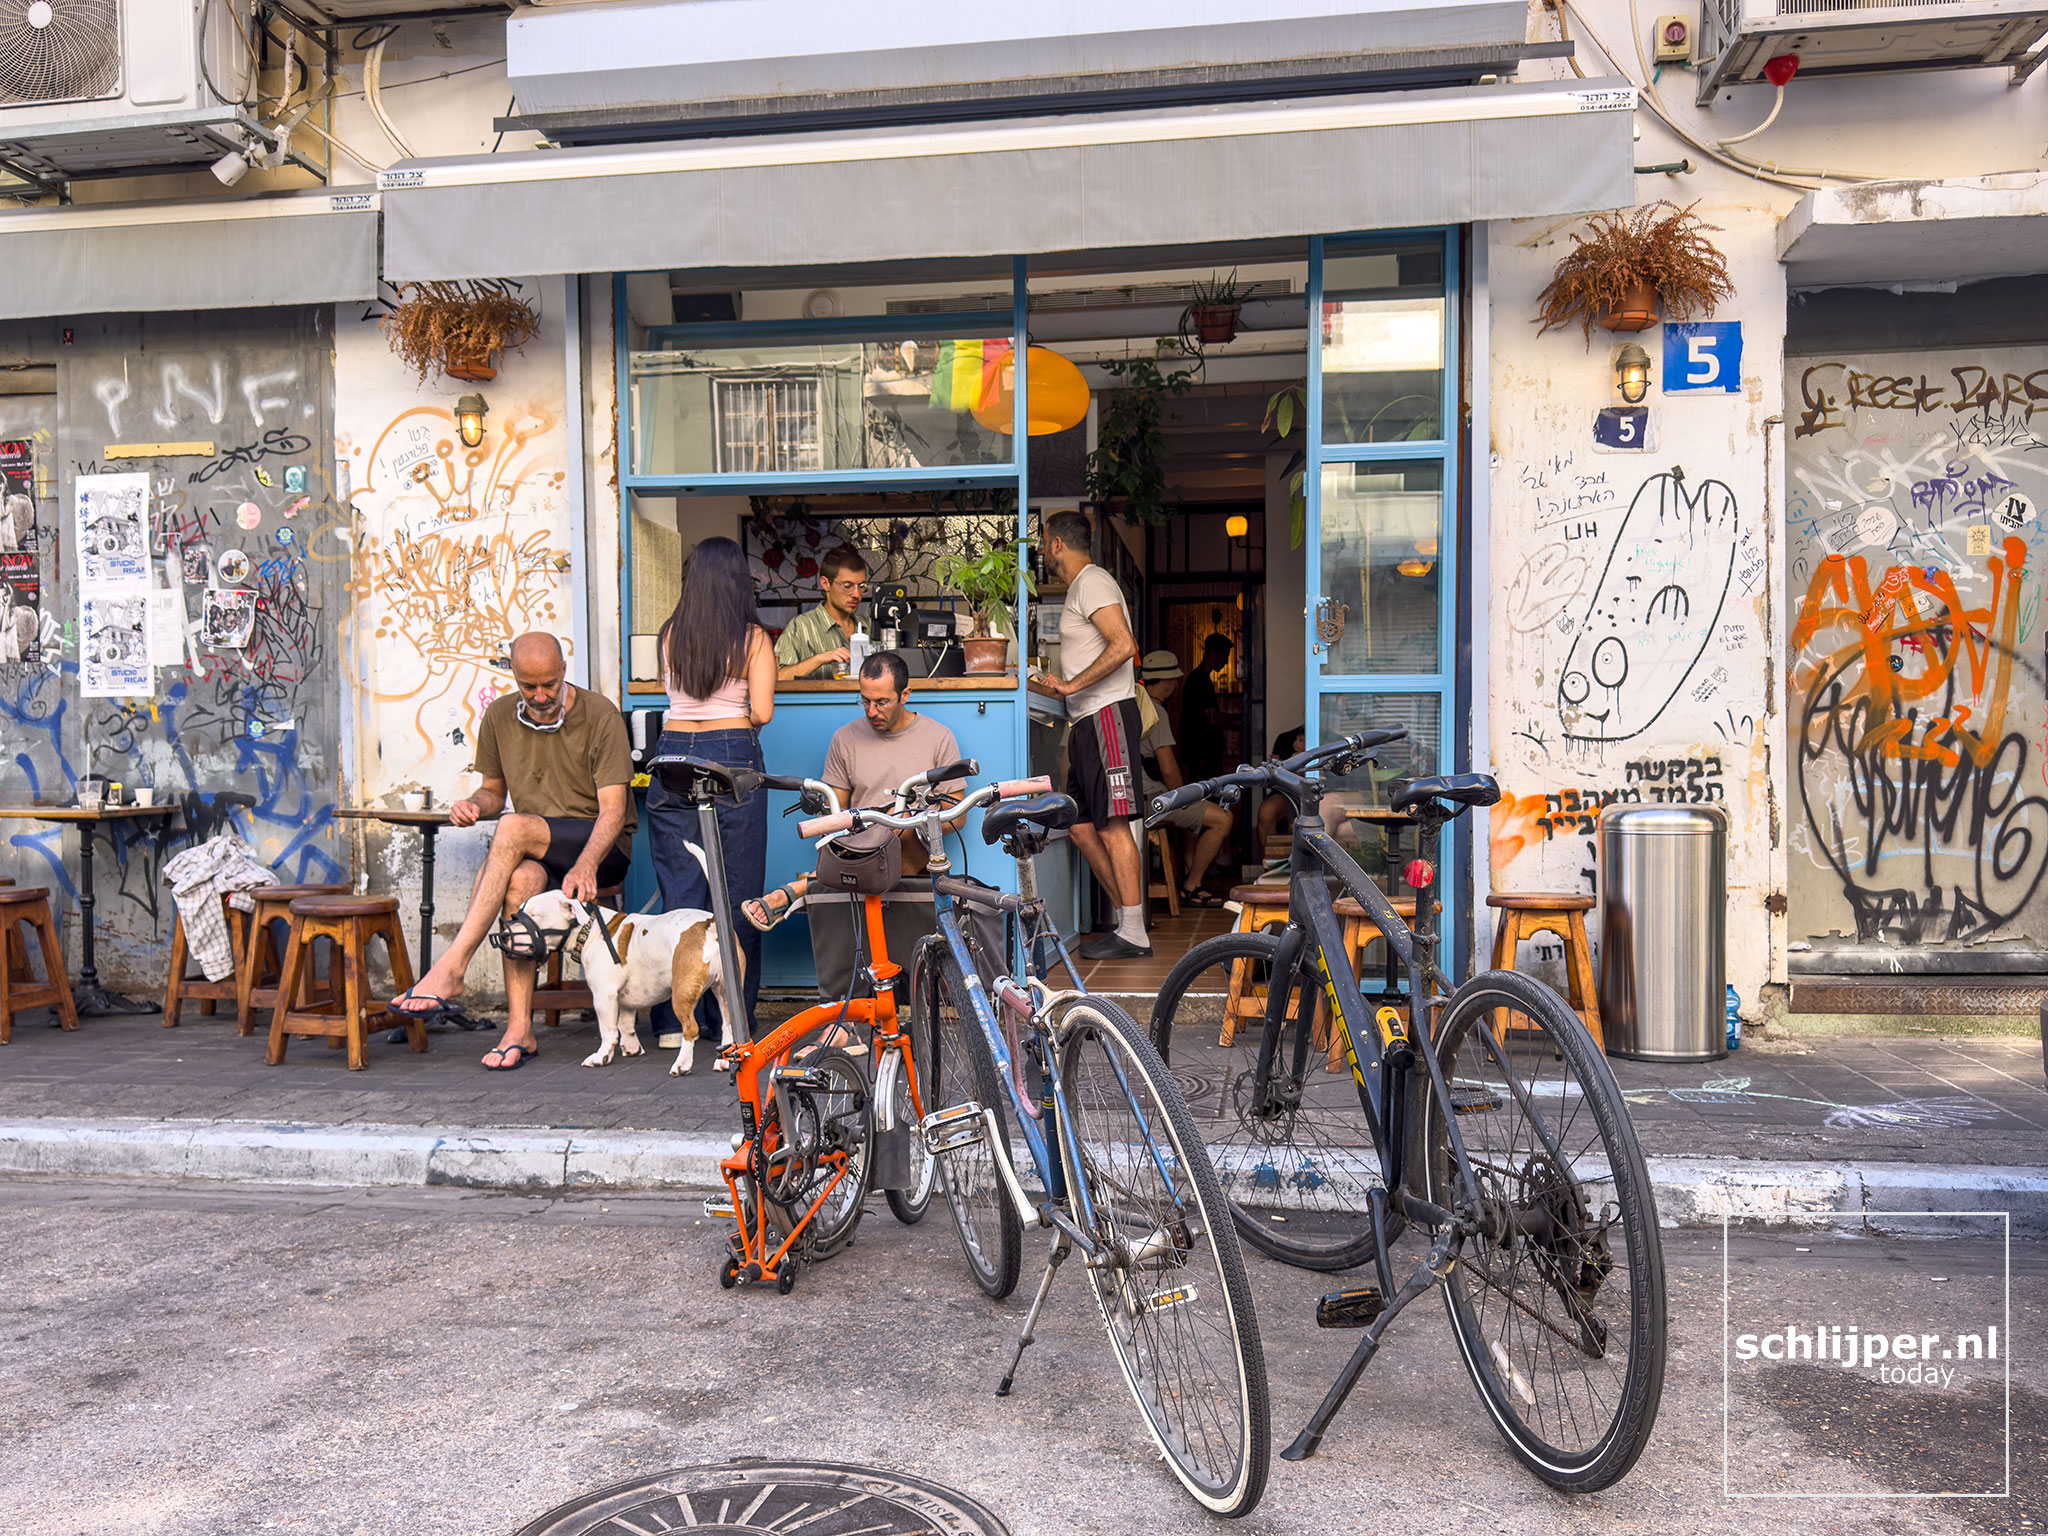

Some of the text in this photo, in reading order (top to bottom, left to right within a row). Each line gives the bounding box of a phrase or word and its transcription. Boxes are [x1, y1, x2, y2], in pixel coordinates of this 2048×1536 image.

[1687, 336, 1720, 384] 5
[1618, 416, 1635, 442] 5
[1625, 757, 1723, 784] בבקשה
[1545, 777, 1724, 813] תלמד מאהבה
[1317, 945, 1367, 1089] TREK
